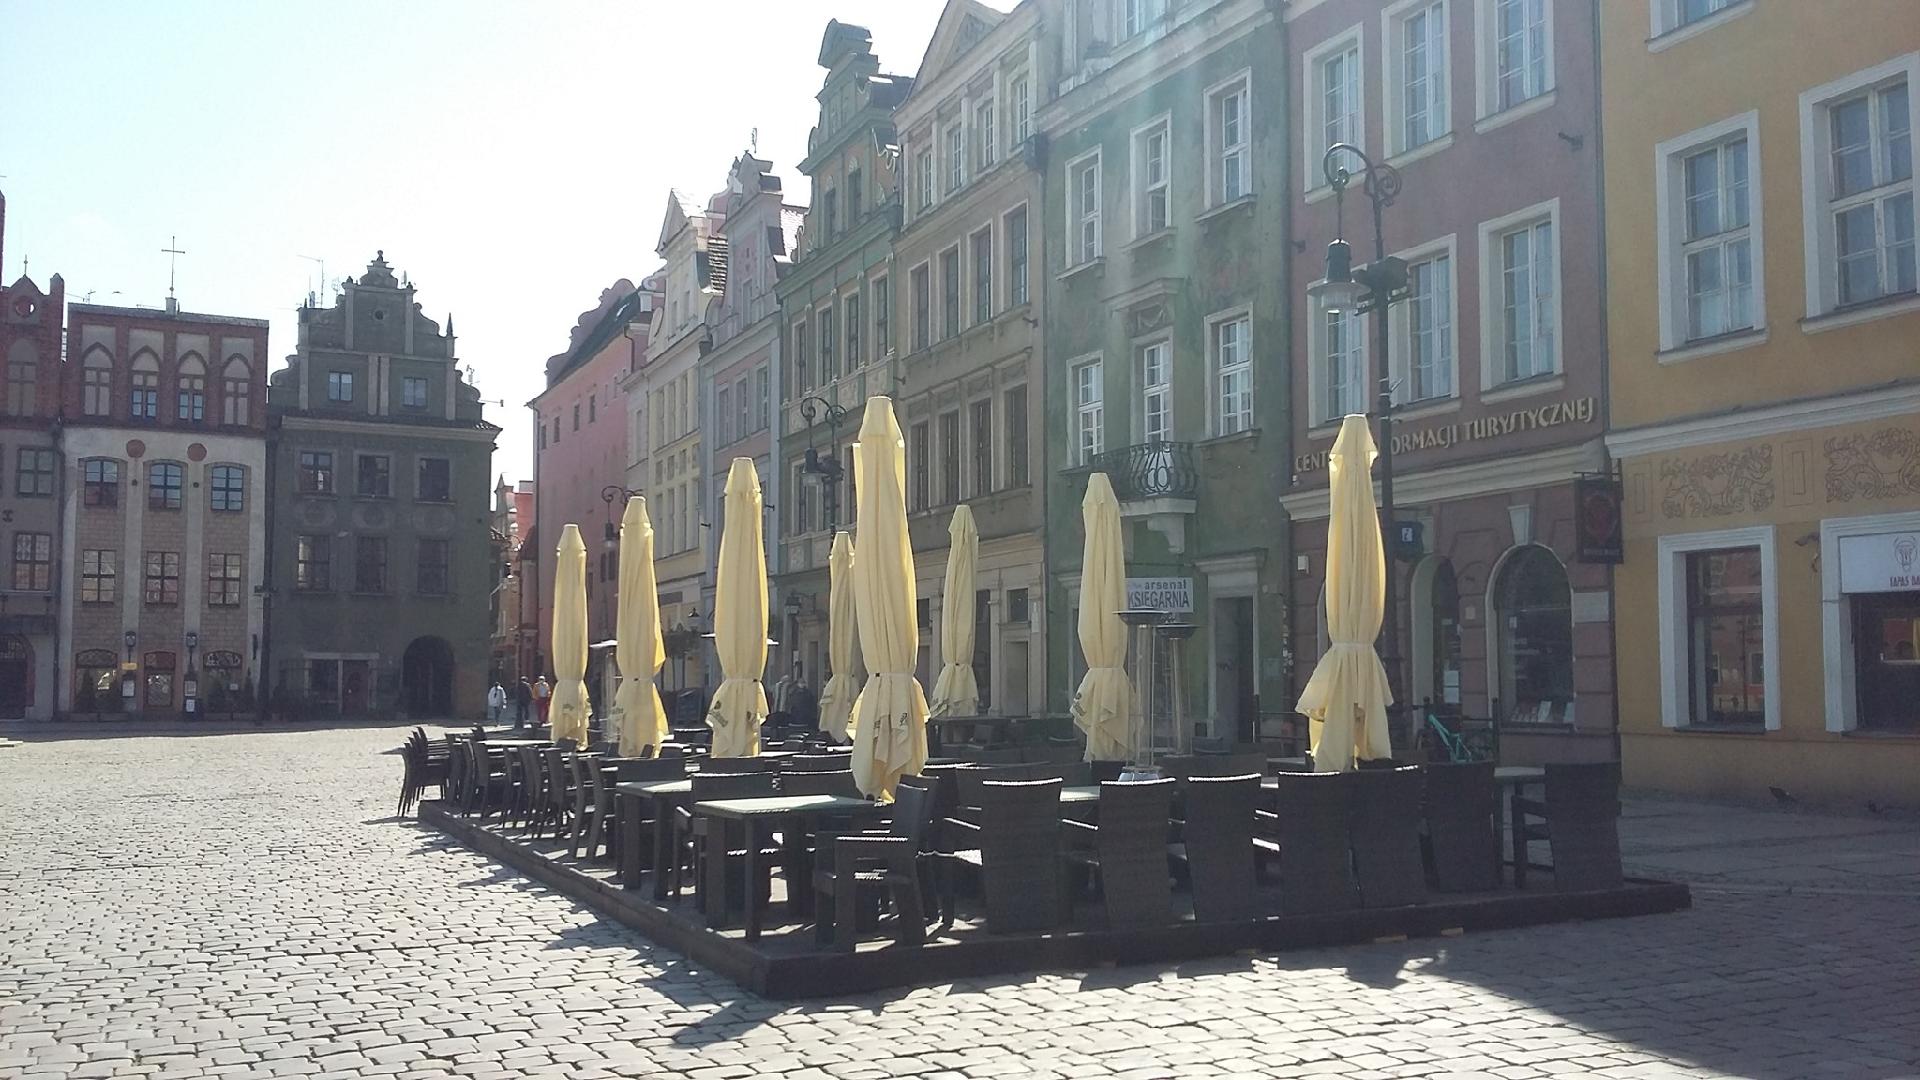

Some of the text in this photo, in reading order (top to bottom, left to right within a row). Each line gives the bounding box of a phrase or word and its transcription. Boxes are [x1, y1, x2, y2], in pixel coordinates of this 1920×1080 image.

[1294, 396, 1593, 473] CENT ORMACJI TURYSTYCZNEJ
